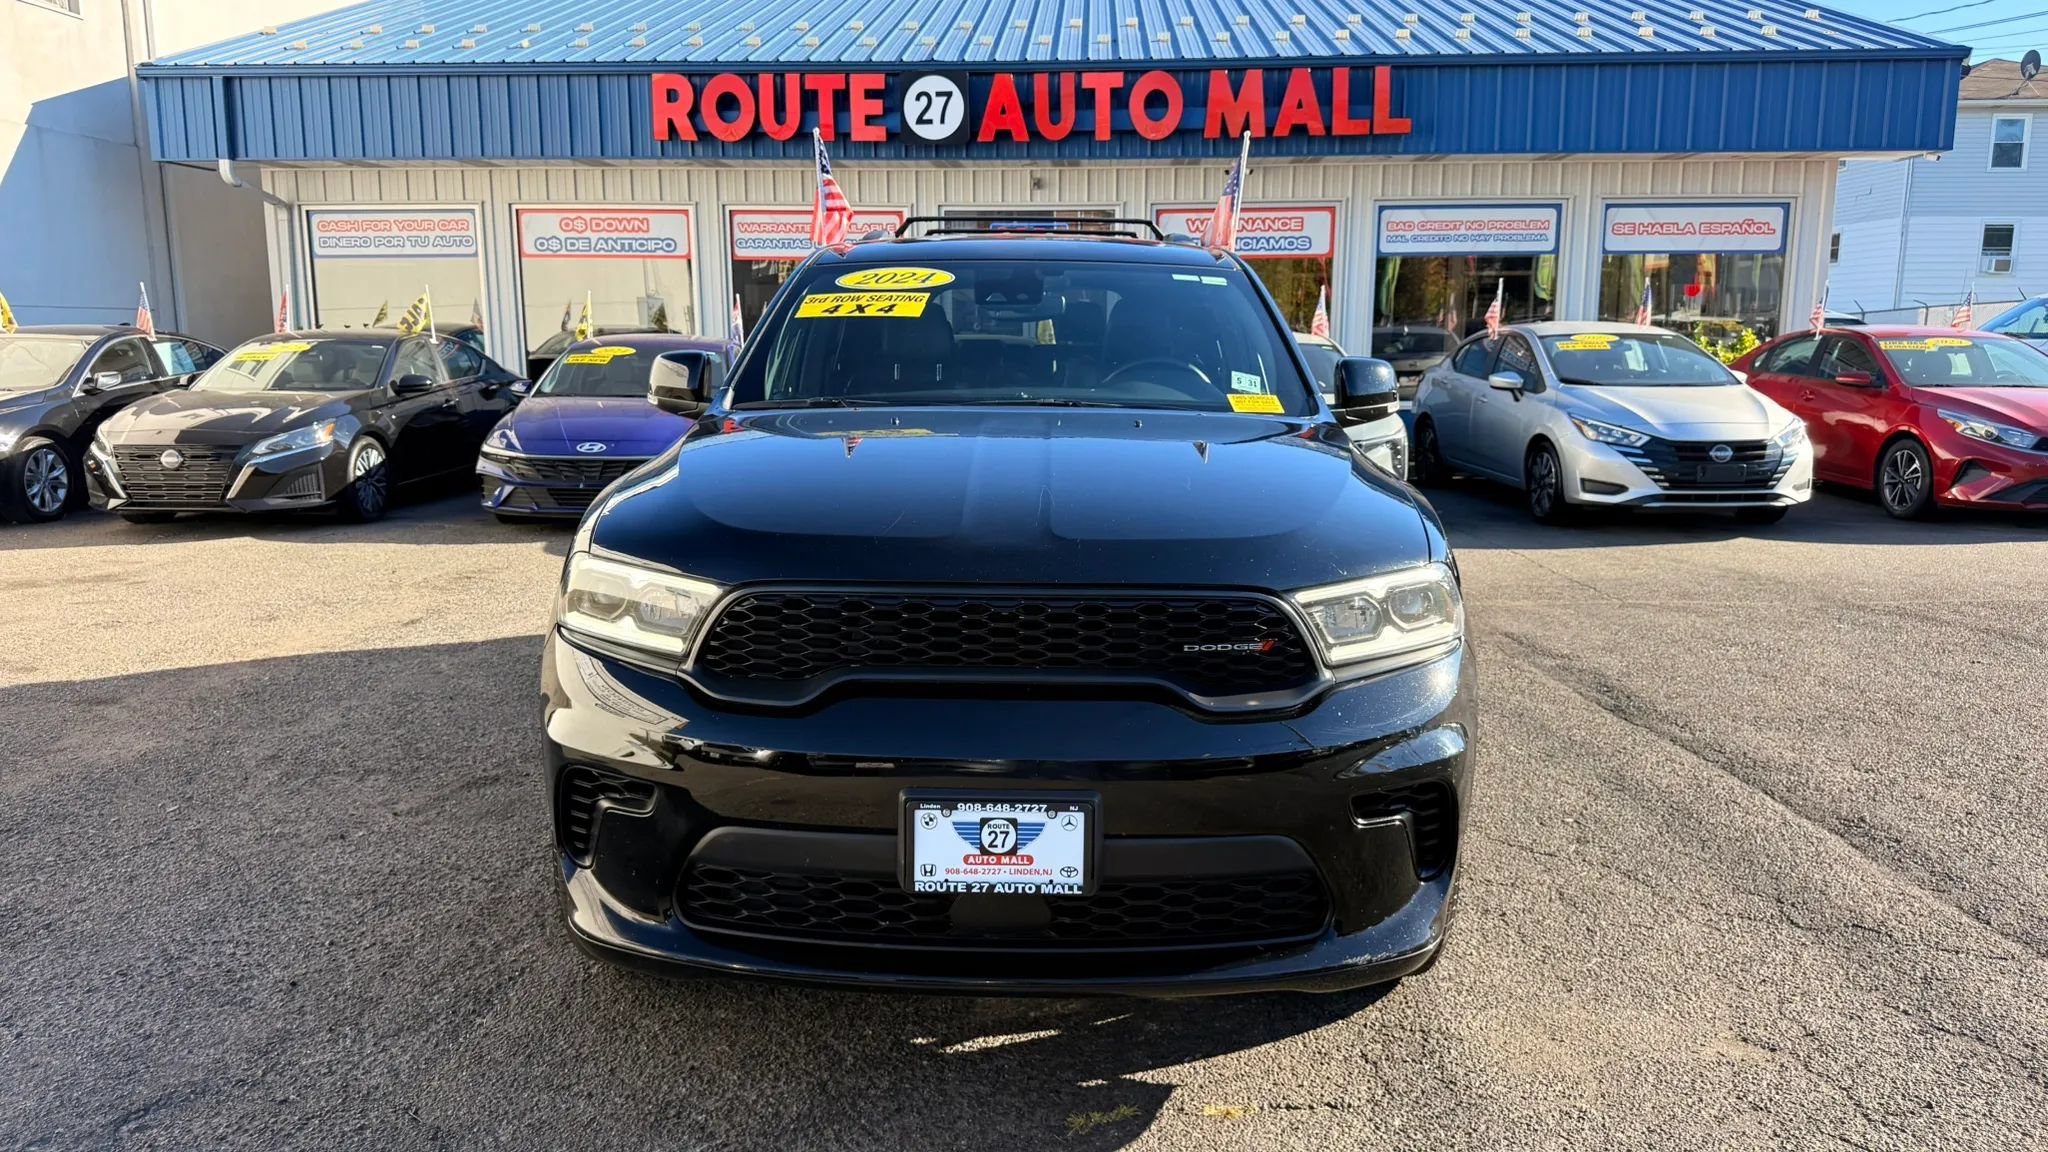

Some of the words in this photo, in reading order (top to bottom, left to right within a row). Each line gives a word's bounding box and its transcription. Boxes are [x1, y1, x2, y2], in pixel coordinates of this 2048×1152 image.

[651, 72, 887, 142] ROUTE
[914, 91, 954, 125] 27
[978, 72, 1182, 141] AUTO
[1204, 66, 1412, 139] MALL
[318, 220, 359, 232] CASH
[361, 220, 392, 232] FOR
[393, 220, 434, 232] YOUR
[437, 220, 469, 231] CAR
[590, 218, 649, 232] DOWN
[737, 222, 812, 233] WARRANTIE
[1387, 220, 1415, 232] BAD
[1417, 220, 1463, 231] CREDIT
[1465, 220, 1486, 231] NO
[1488, 220, 1550, 230] PROBLEM
[1612, 222, 1636, 235] SE
[1638, 222, 1696, 235] HABLA
[1698, 218, 1775, 234] ESPAÑOL
[318, 236, 372, 248] DINERO
[374, 236, 404, 248] POR
[407, 236, 429, 247] TU
[432, 235, 474, 248] AUTO
[736, 238, 813, 248] GARANTIAS
[1386, 234, 1409, 243] MAL
[1410, 234, 1452, 243] CREDITO
[1454, 234, 1470, 242] NO
[1493, 233, 1548, 242] PROBLEMA
[565, 237, 591, 252] DE
[594, 237, 677, 252] ANTICIPO
[854, 272, 936, 285] 2024
[1184, 643, 1263, 652] DODGE
[957, 803, 1047, 813] 908-648-2727
[988, 830, 1010, 848] 27
[968, 856, 997, 864] AUTO
[1000, 856, 1030, 864] MALL
[945, 868, 1001, 876] 908-648-2727
[1009, 868, 1052, 876] LINDEN,NJ
[914, 882, 967, 893] ROUTE
[971, 882, 988, 893] 27
[994, 883, 1036, 894] AUTO
[1041, 883, 1082, 894] MALL
